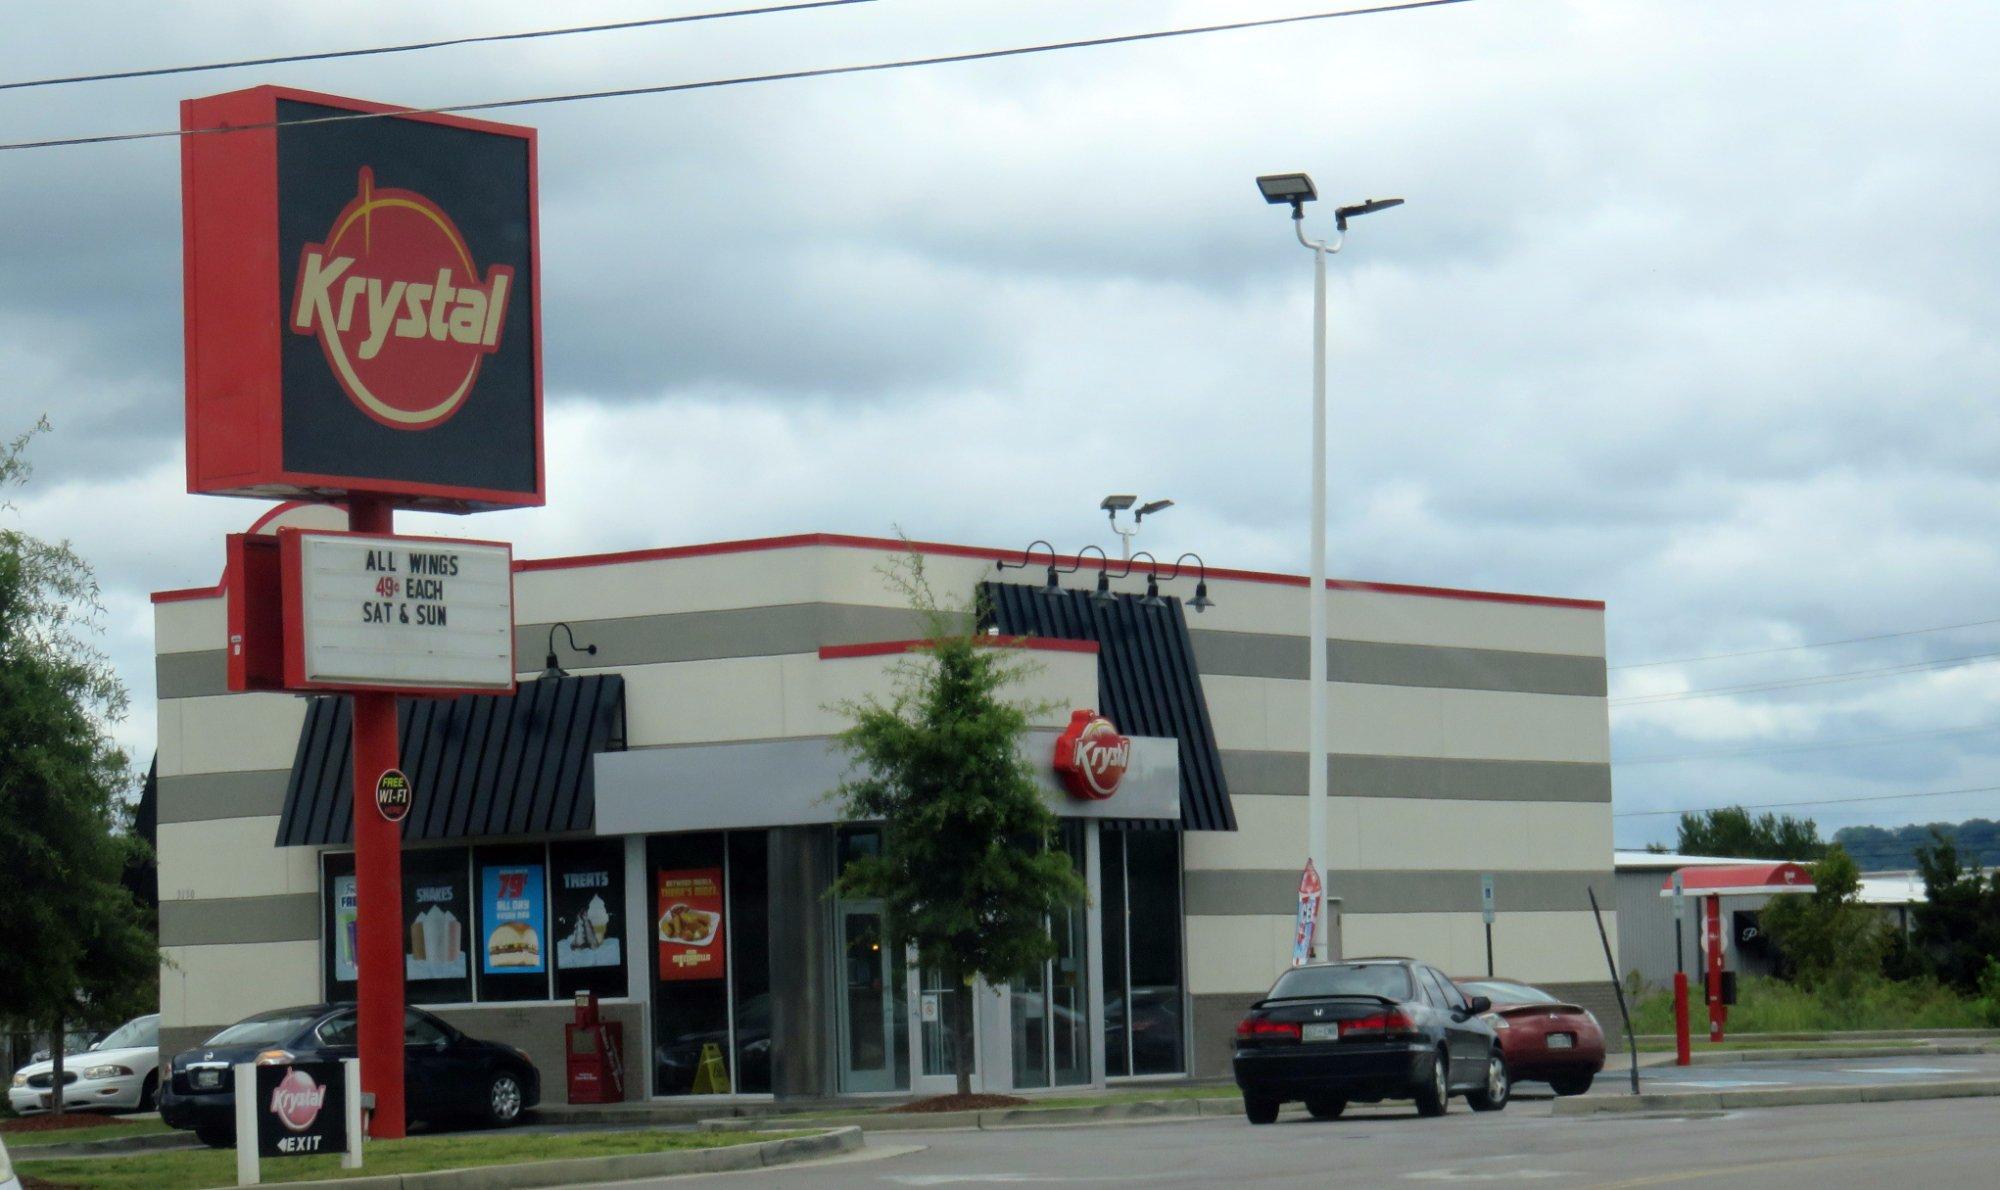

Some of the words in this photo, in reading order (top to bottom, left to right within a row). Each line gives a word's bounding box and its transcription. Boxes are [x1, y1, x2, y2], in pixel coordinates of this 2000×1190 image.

[296, 252, 508, 361] Krystal
[366, 550, 396, 572] ALL
[409, 552, 458, 576] WINGS
[406, 578, 443, 601] EACH
[363, 601, 393, 623] SAT
[400, 602, 410, 624] &
[416, 604, 447, 626] SUN
[383, 777, 404, 788] FREE
[379, 788, 408, 803] WI-FI
[563, 871, 609, 889] TREATS
[416, 886, 454, 902] SHAKES
[273, 1086, 325, 1114] Krystal
[287, 1136, 321, 1152] EXIT
